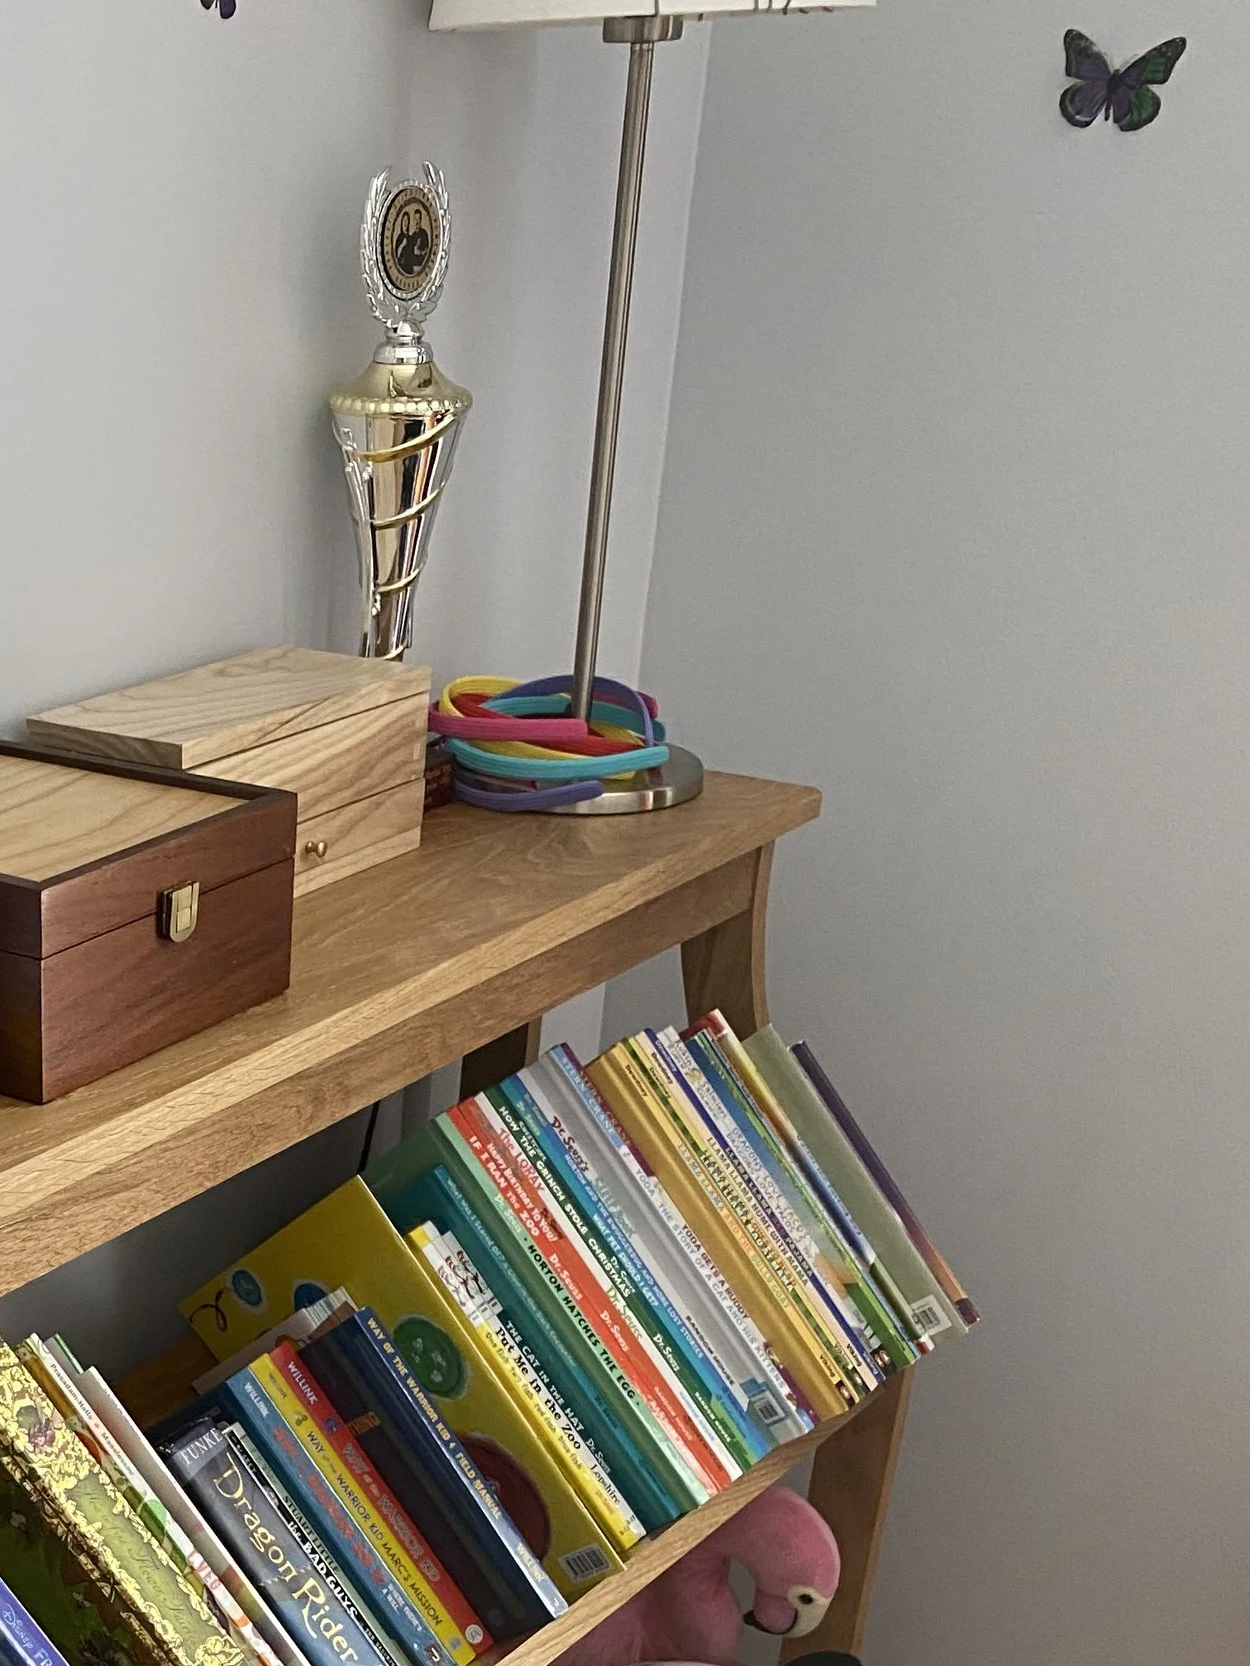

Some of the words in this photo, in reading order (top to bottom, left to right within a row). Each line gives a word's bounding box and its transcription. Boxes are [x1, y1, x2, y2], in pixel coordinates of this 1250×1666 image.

[466, 1135, 481, 1151] IF
[484, 1161, 508, 1190] RAN
[517, 1209, 542, 1238] ZOO
[497, 1105, 520, 1134] HOW
[517, 1135, 537, 1158] THE
[533, 1159, 567, 1202] GRINCH
[562, 1202, 589, 1235] STOLE
[585, 1236, 634, 1299] CHRISTMAS
[284, 1359, 320, 1405] WILLINK
[503, 1319, 523, 1342] THE
[519, 1343, 541, 1369] CAT
[537, 1369, 551, 1383] IN
[548, 1383, 567, 1405] THE
[563, 1405, 586, 1433] HAT
[525, 1242, 565, 1293] HORTON
[560, 1294, 602, 1347] HATCHES
[598, 1347, 619, 1372] THE
[615, 1372, 638, 1400] EGG
[180, 1426, 223, 1466] FUNKE
[365, 1316, 386, 1341] WAY
[381, 1340, 395, 1355] OF
[390, 1354, 409, 1376] THE
[402, 1375, 440, 1423] WARRIOR
[434, 1420, 453, 1441] KID
[453, 1450, 477, 1479] FIELD
[493, 1326, 517, 1354] Put
[512, 1354, 532, 1377] Me
[527, 1375, 546, 1395] in
[541, 1396, 564, 1422] the
[559, 1422, 584, 1451] Zoo
[588, 1463, 622, 1506] Lopshire
[213, 1452, 297, 1582] Dragon
[291, 1579, 360, 1661] Rider
[281, 1494, 314, 1536] STUART
[301, 1541, 329, 1575] BAD
[324, 1574, 359, 1617] GUYS
[304, 1429, 325, 1455] WAY
[333, 1472, 372, 1522] WARRIOR
[367, 1522, 385, 1541] KID
[379, 1540, 412, 1581] MARC'S
[406, 1580, 442, 1626] MISSION
